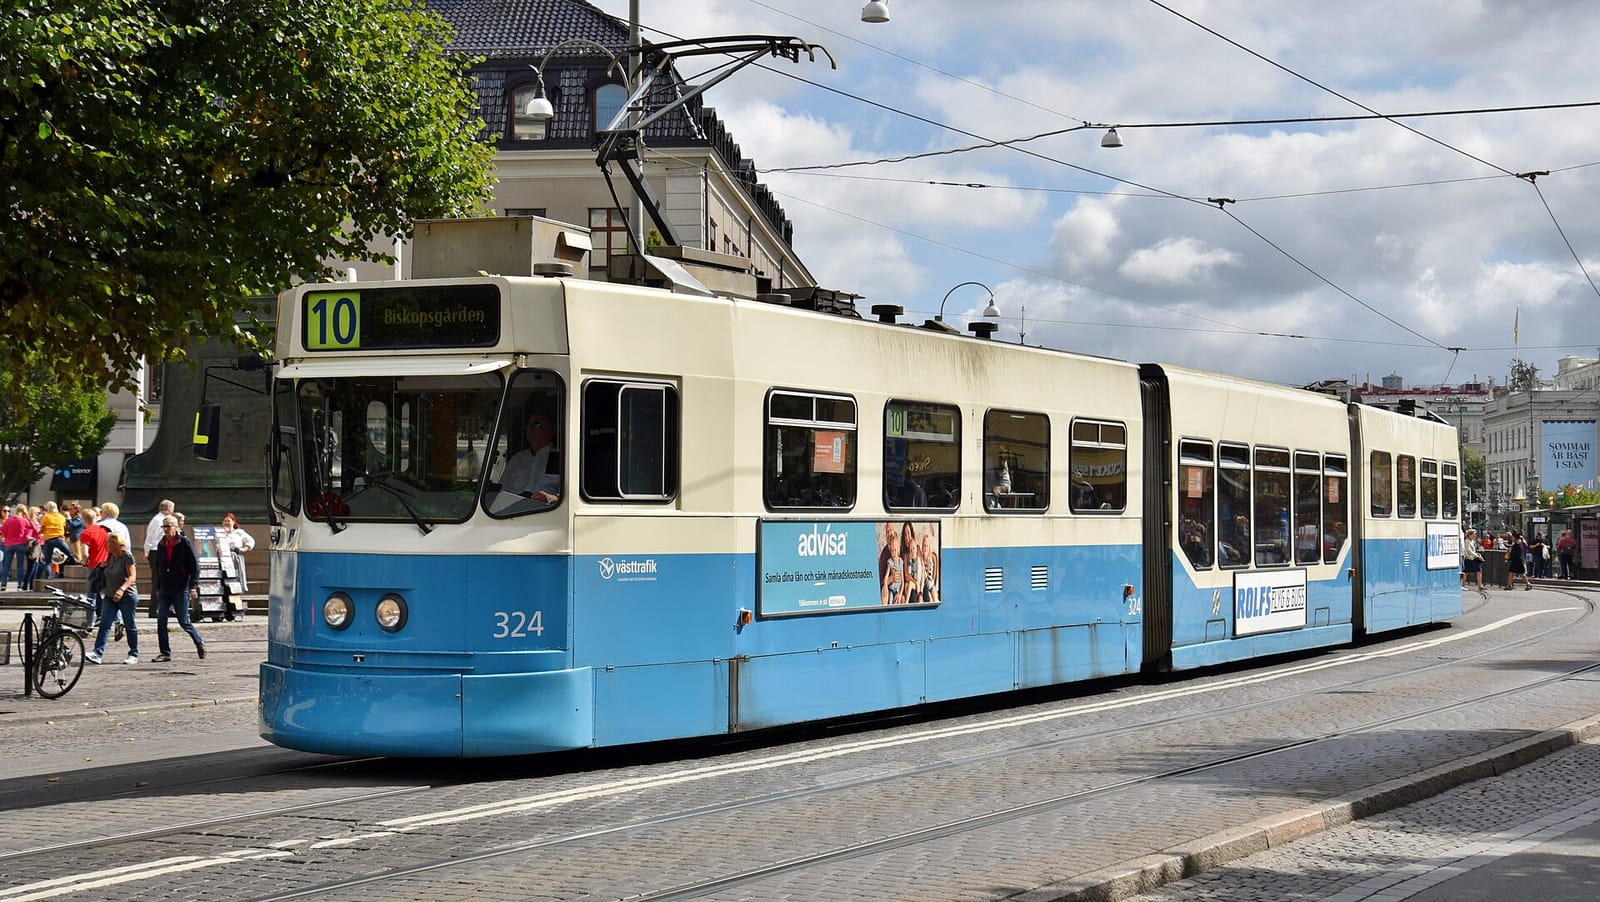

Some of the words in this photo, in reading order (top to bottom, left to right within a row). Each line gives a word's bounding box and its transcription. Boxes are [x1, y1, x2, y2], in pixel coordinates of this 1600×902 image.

[311, 297, 357, 345] 10
[384, 306, 485, 328] Biskopsgården
[890, 411, 901, 433] 10
[1549, 442, 1590, 451] SOMMAR
[1551, 450, 1564, 460] ÄR
[1566, 450, 1588, 460] BÄST
[1562, 460, 1584, 469] STAN
[616, 559, 657, 574] västtrafik
[765, 572, 781, 583] Samla
[782, 571, 794, 582] dina
[795, 571, 803, 582] lån
[804, 571, 814, 581] och
[815, 570, 827, 580] sänk
[828, 569, 873, 580] månadskostnaden.
[1128, 598, 1141, 615] 324
[1237, 586, 1272, 619] ROLFS
[1272, 589, 1285, 609] FLYG
[1286, 590, 1290, 607] &
[1291, 588, 1304, 608] BUSS
[494, 611, 544, 638] 324
